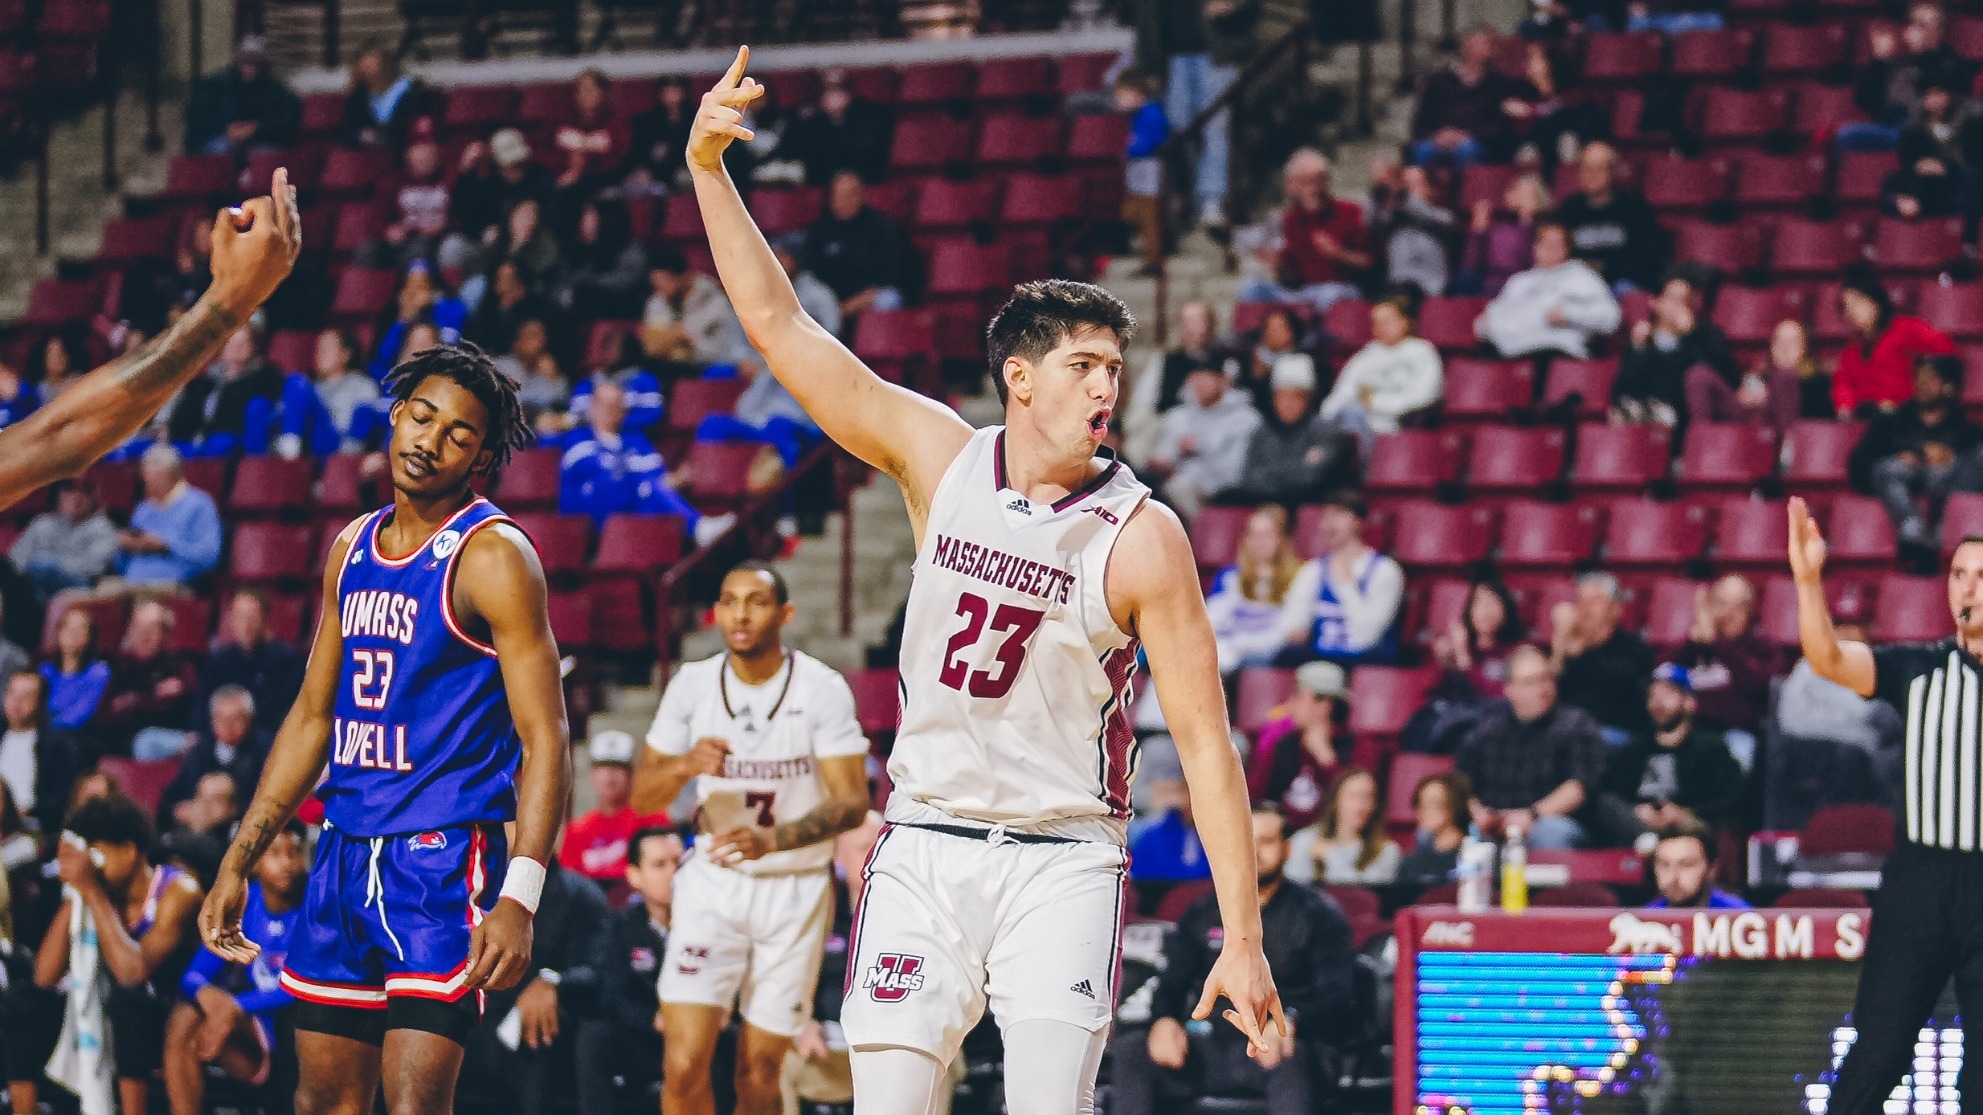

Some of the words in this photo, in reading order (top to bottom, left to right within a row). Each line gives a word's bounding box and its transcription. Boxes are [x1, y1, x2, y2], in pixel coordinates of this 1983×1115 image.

[1006, 503, 1032, 516] adidas
[341, 590, 418, 645] UMASS
[938, 591, 1046, 699] 23
[352, 649, 394, 711] 23
[745, 791, 776, 828] 7
[1692, 911, 1816, 960] MGM
[1070, 986, 1096, 1000] adidas
